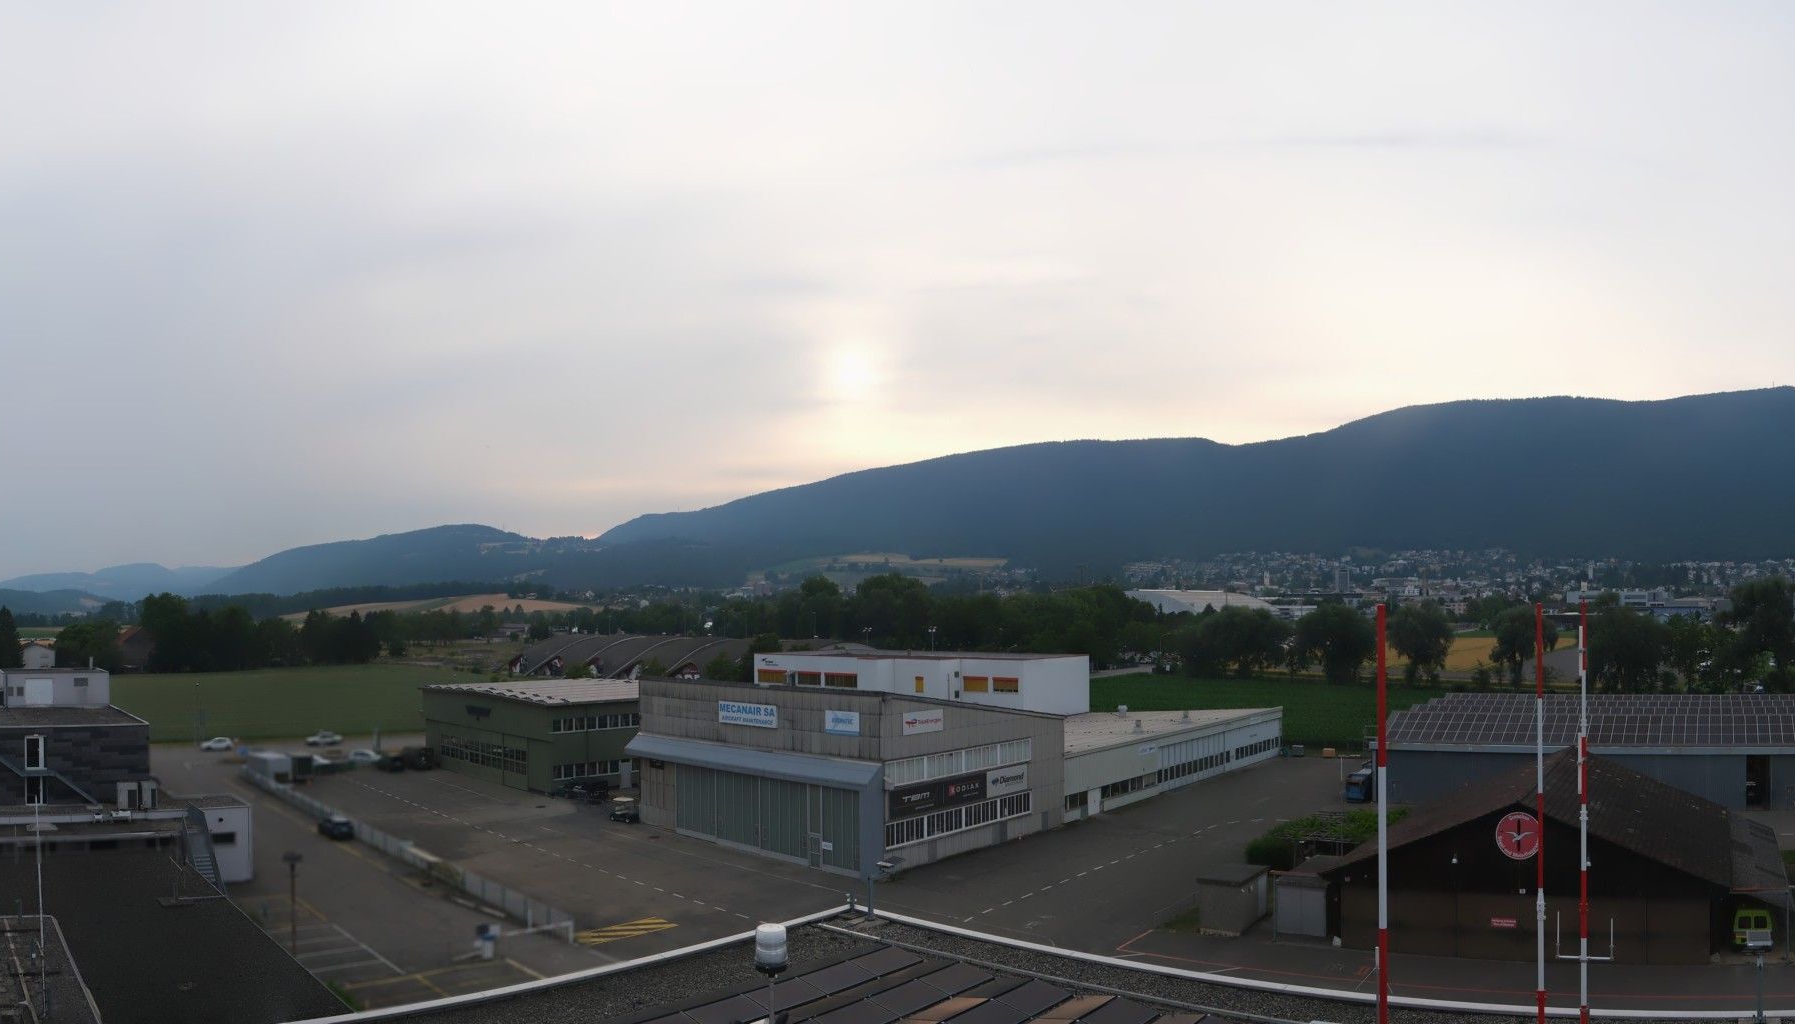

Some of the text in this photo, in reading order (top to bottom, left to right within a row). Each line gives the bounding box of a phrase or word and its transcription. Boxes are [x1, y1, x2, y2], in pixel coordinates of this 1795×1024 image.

[719, 703, 775, 717] MECANAIR SA
[999, 772, 1025, 785] Diamond
[948, 783, 979, 797] KODIAK
